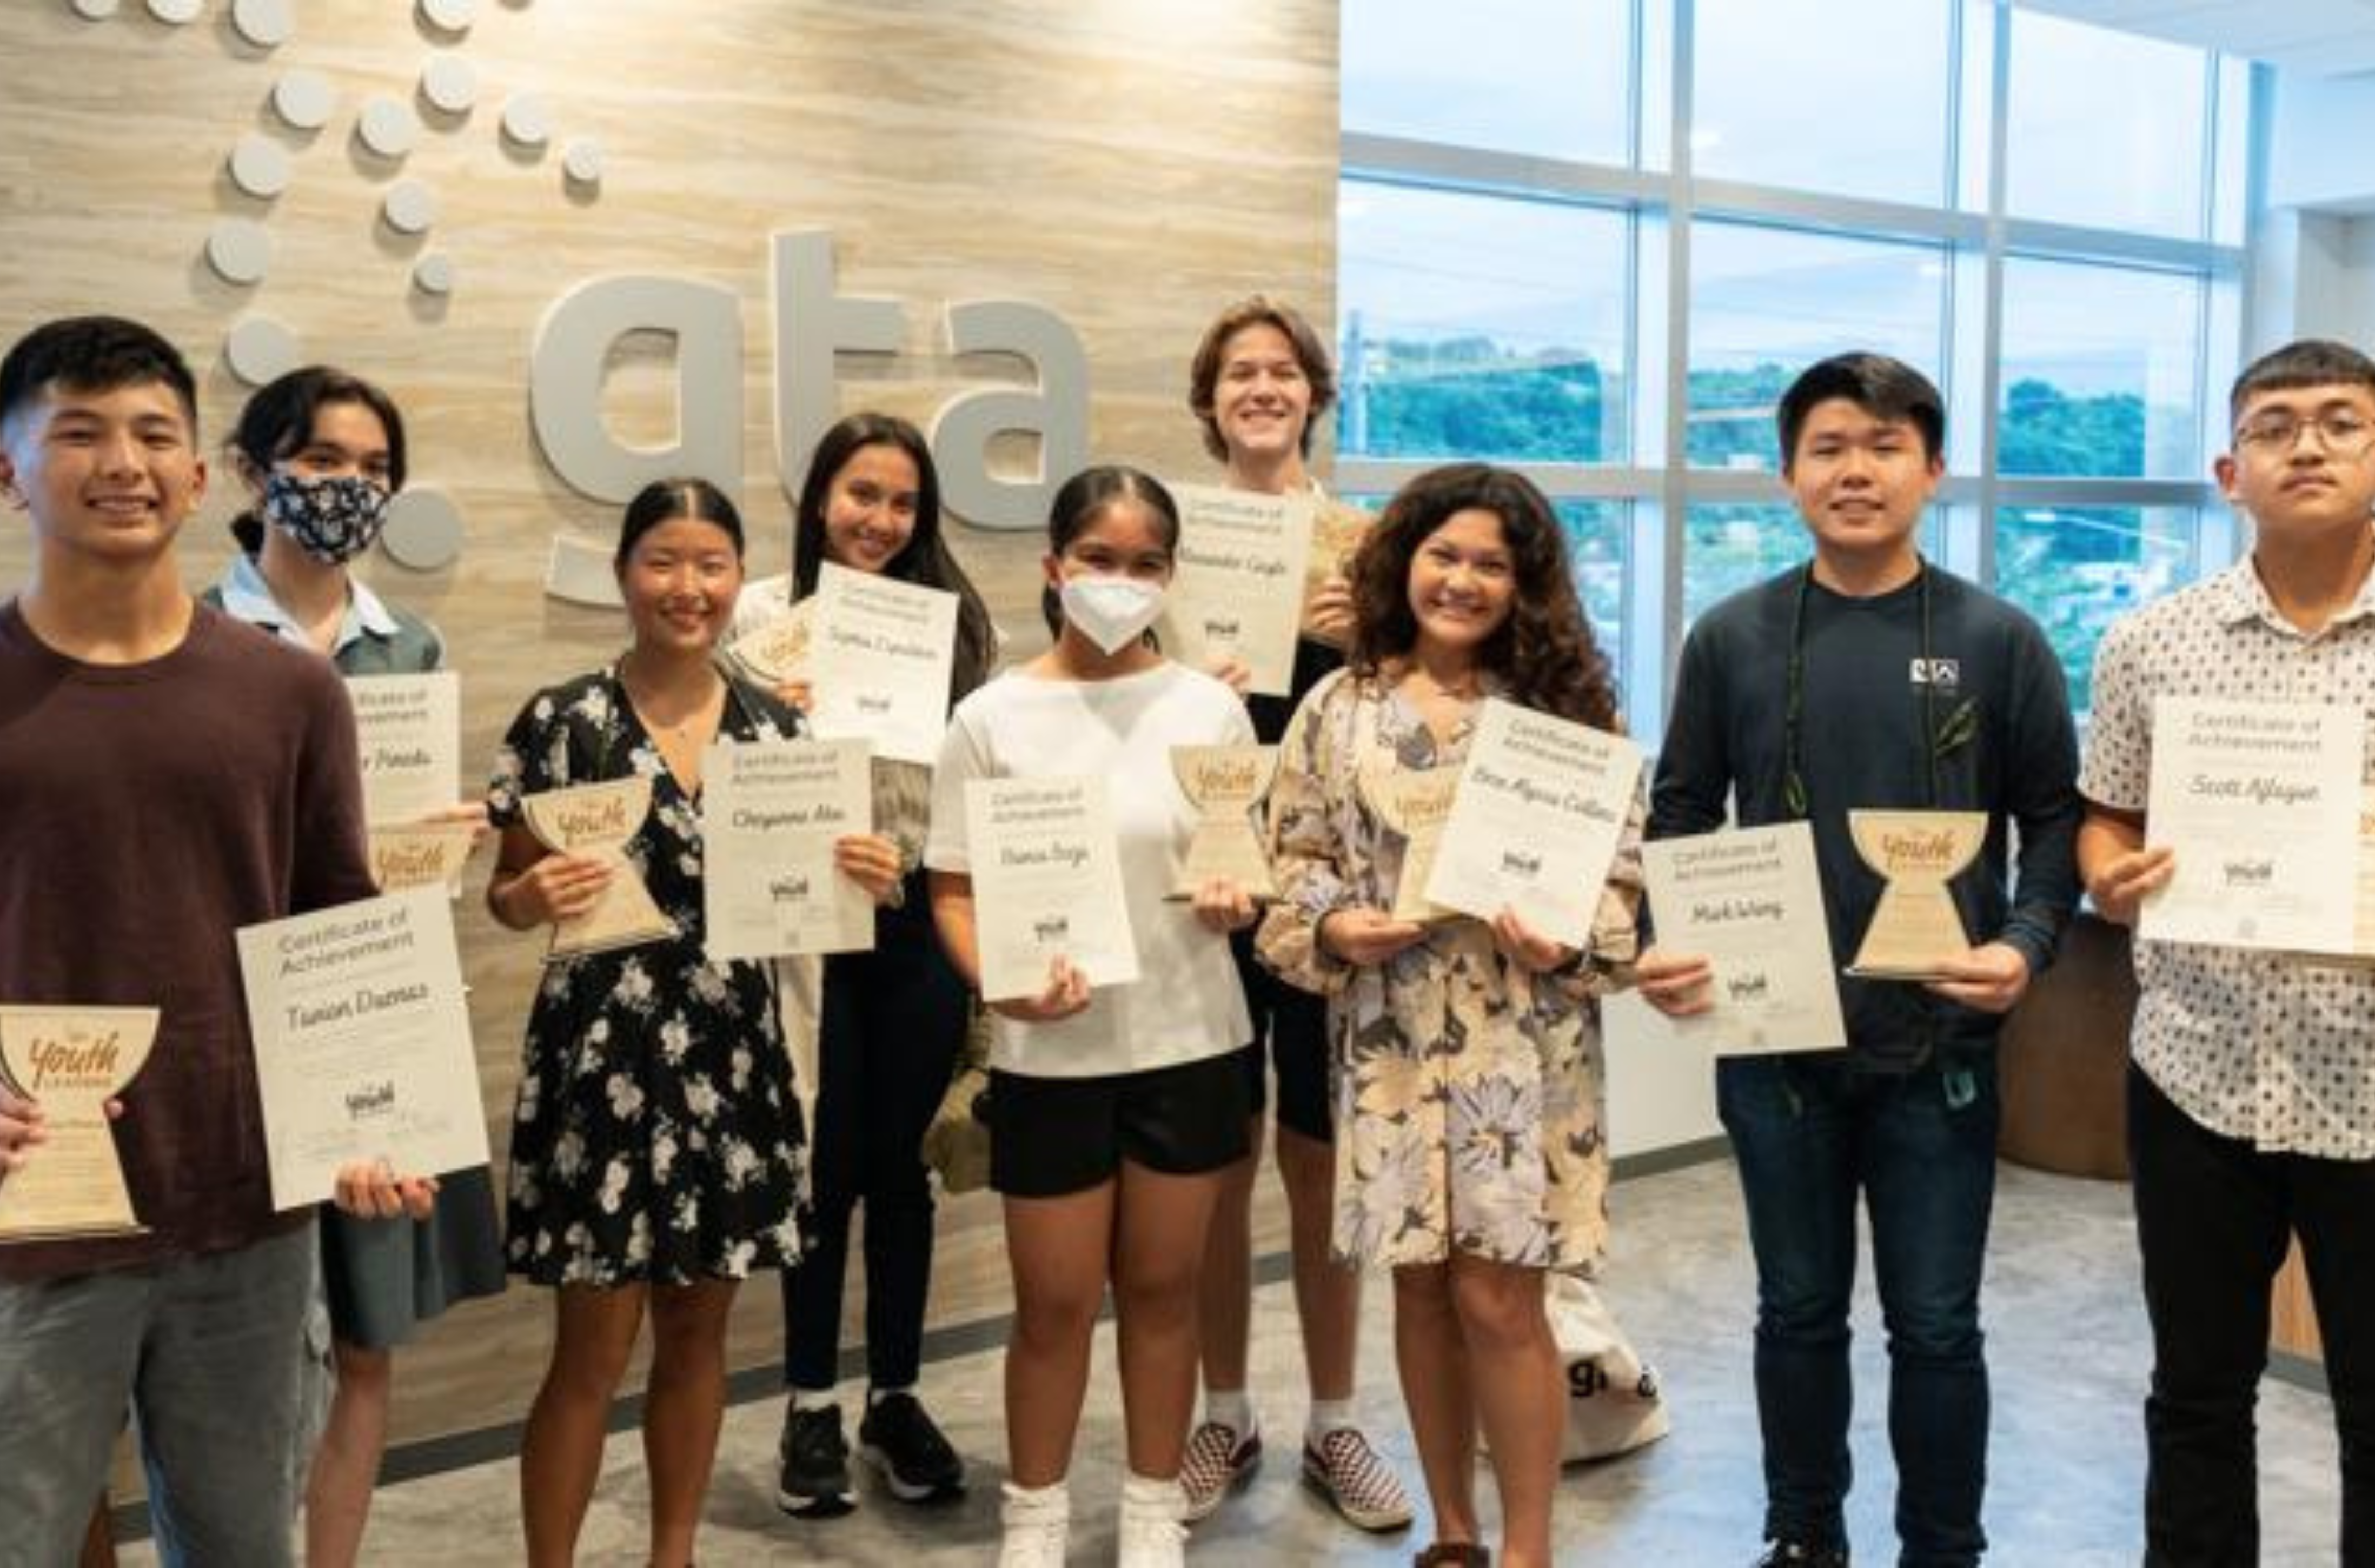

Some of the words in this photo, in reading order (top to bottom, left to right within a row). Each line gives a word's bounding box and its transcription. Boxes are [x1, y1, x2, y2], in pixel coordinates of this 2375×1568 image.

[529, 227, 1090, 607] gta
[2188, 732, 2321, 753] Achievement
[2192, 712, 2295, 732] Certificate
[2300, 719, 2321, 734] of
[277, 916, 383, 954] Certificate
[388, 905, 408, 928] of
[278, 931, 414, 980] Achievement
